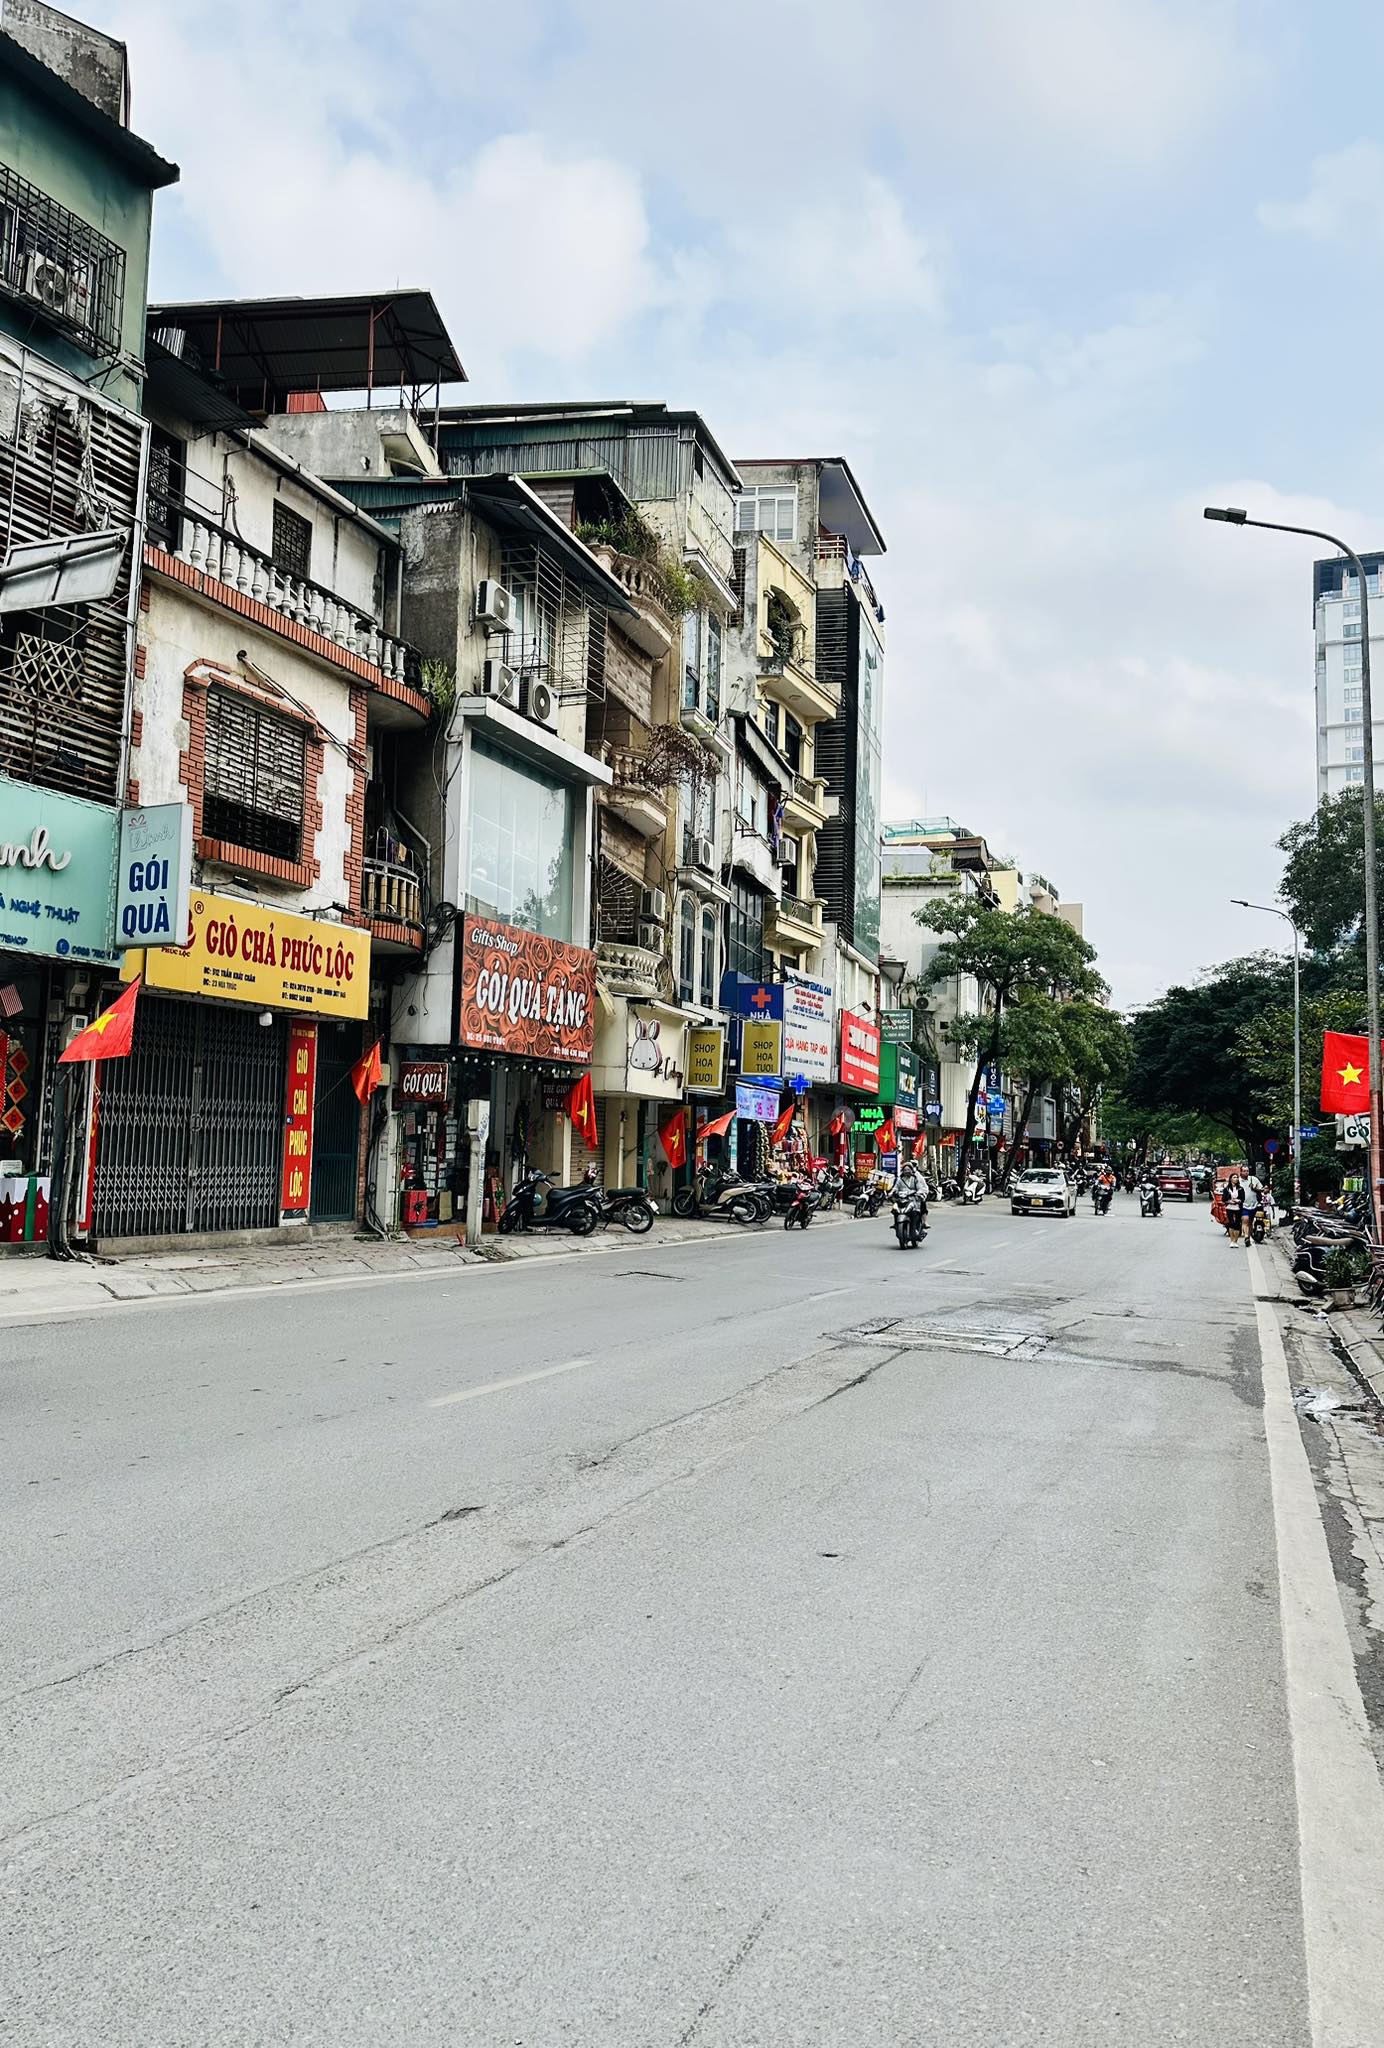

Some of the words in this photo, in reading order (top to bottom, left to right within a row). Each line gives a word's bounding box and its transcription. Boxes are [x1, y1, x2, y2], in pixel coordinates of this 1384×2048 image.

[128, 853, 169, 893] GÓI
[44, 904, 81, 926] THUẬT
[121, 896, 170, 938] QUÀ
[206, 914, 239, 958] GIÒ
[241, 922, 277, 967] CHẢ
[280, 934, 323, 975] PHÚC
[325, 940, 355, 987] LỘC
[471, 928, 494, 949] Gifts
[494, 933, 518, 956] Shop
[476, 960, 509, 1014] GÓI
[507, 970, 543, 1025] QUÀ
[546, 977, 586, 1033] TẶNG
[750, 1009, 771, 1020] NHÀ
[296, 1043, 308, 1075] GIÒ
[694, 1043, 716, 1053] SHOP
[753, 1040, 774, 1049] SHOP
[756, 1053, 773, 1061] HOA
[695, 1058, 713, 1067] HOA
[403, 1068, 421, 1094] GÓI
[421, 1068, 443, 1097] QUÀ
[293, 1082, 308, 1116] CHẢ
[860, 1106, 885, 1119] NHÀ
[288, 1127, 308, 1156] PHÚC
[288, 1166, 303, 1203] LỘC
